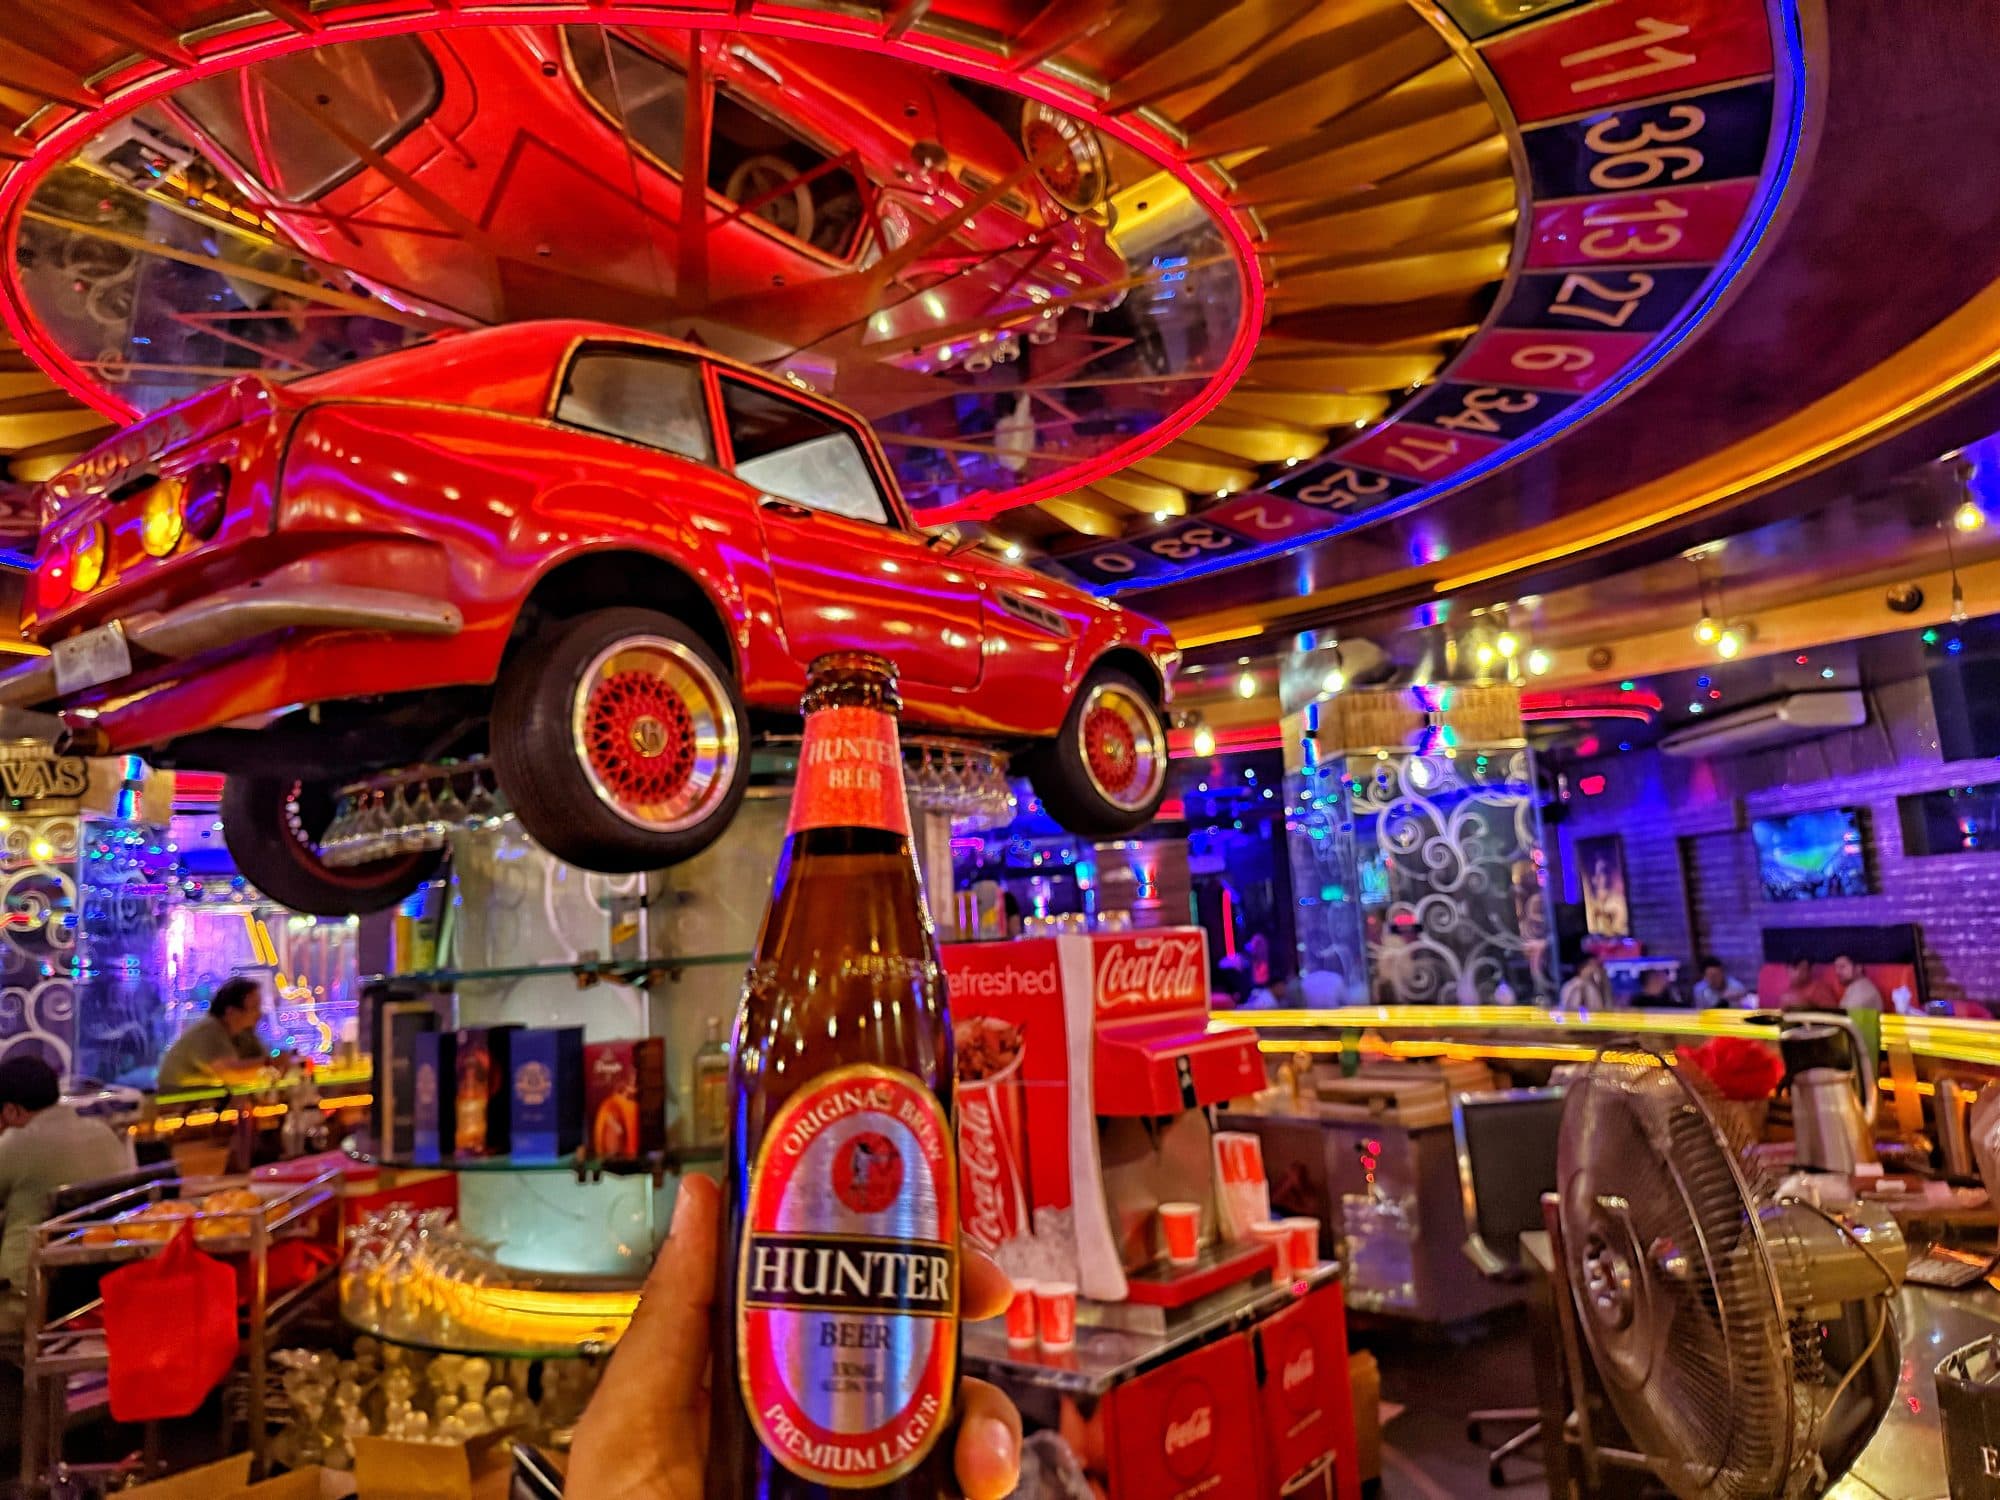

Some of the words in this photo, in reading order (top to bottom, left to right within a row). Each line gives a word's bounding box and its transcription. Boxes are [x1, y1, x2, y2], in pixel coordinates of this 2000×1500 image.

[1560, 17, 1696, 93] 11
[1585, 105, 1706, 188] 36
[1579, 199, 1689, 258] 13
[1548, 273, 1655, 327] 27
[1511, 345, 1595, 372] 6
[1435, 388, 1539, 432] 34
[1385, 437, 1459, 472] 17
[1297, 468, 1390, 509] 25
[1234, 506, 1294, 530] 2
[1151, 528, 1233, 559] 33
[1092, 553, 1136, 573] 0
[829, 767, 881, 790] BEER
[945, 964, 1056, 998] efreshed
[751, 1245, 950, 1301] HUNTER
[820, 1321, 891, 1350] BEER
[764, 1403, 878, 1472] PREMIUM
[879, 1393, 939, 1465] LAGER
